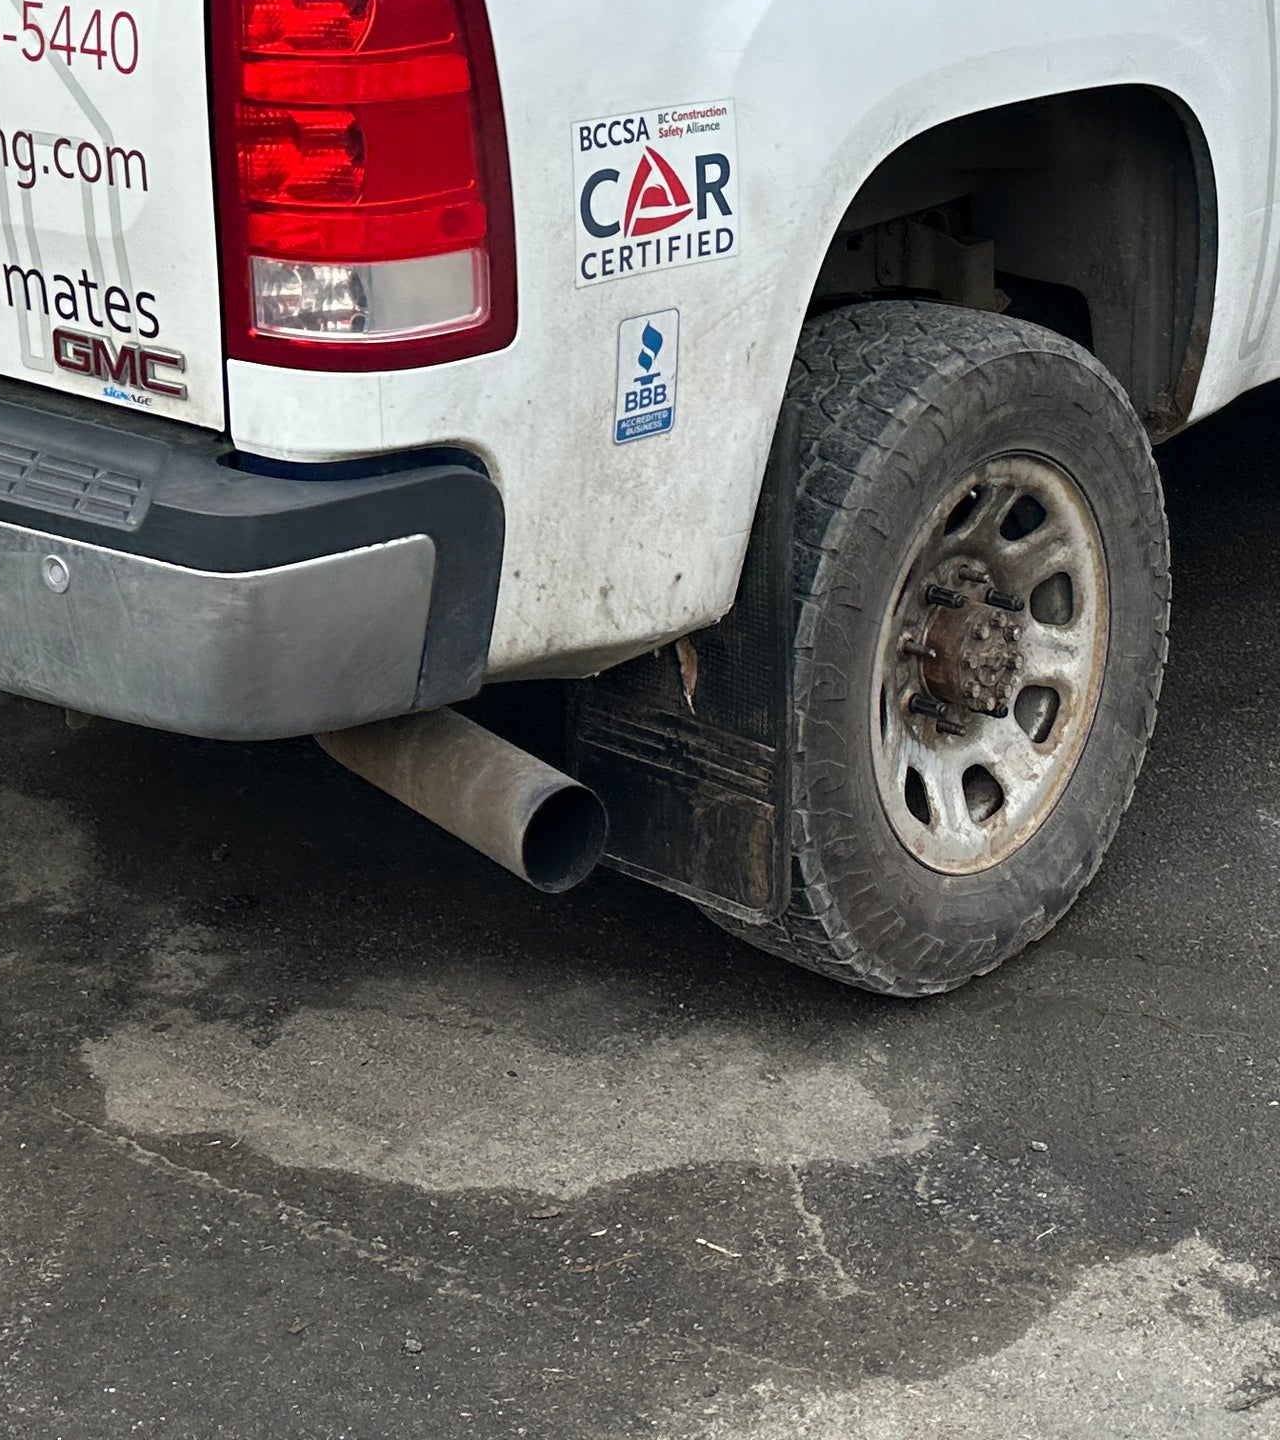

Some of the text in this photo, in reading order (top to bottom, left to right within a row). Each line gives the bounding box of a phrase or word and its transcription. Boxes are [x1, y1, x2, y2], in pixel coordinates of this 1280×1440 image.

[658, 106, 728, 124] BC Construction
[579, 117, 651, 152] BCCSA
[658, 121, 721, 139] Safety Alliance
[581, 227, 734, 280] CERTIFIED
[53, 326, 187, 400] GMC
[625, 384, 667, 413] BBB
[621, 410, 669, 429] ACCREDITED
[625, 420, 663, 436] BUSINESS
